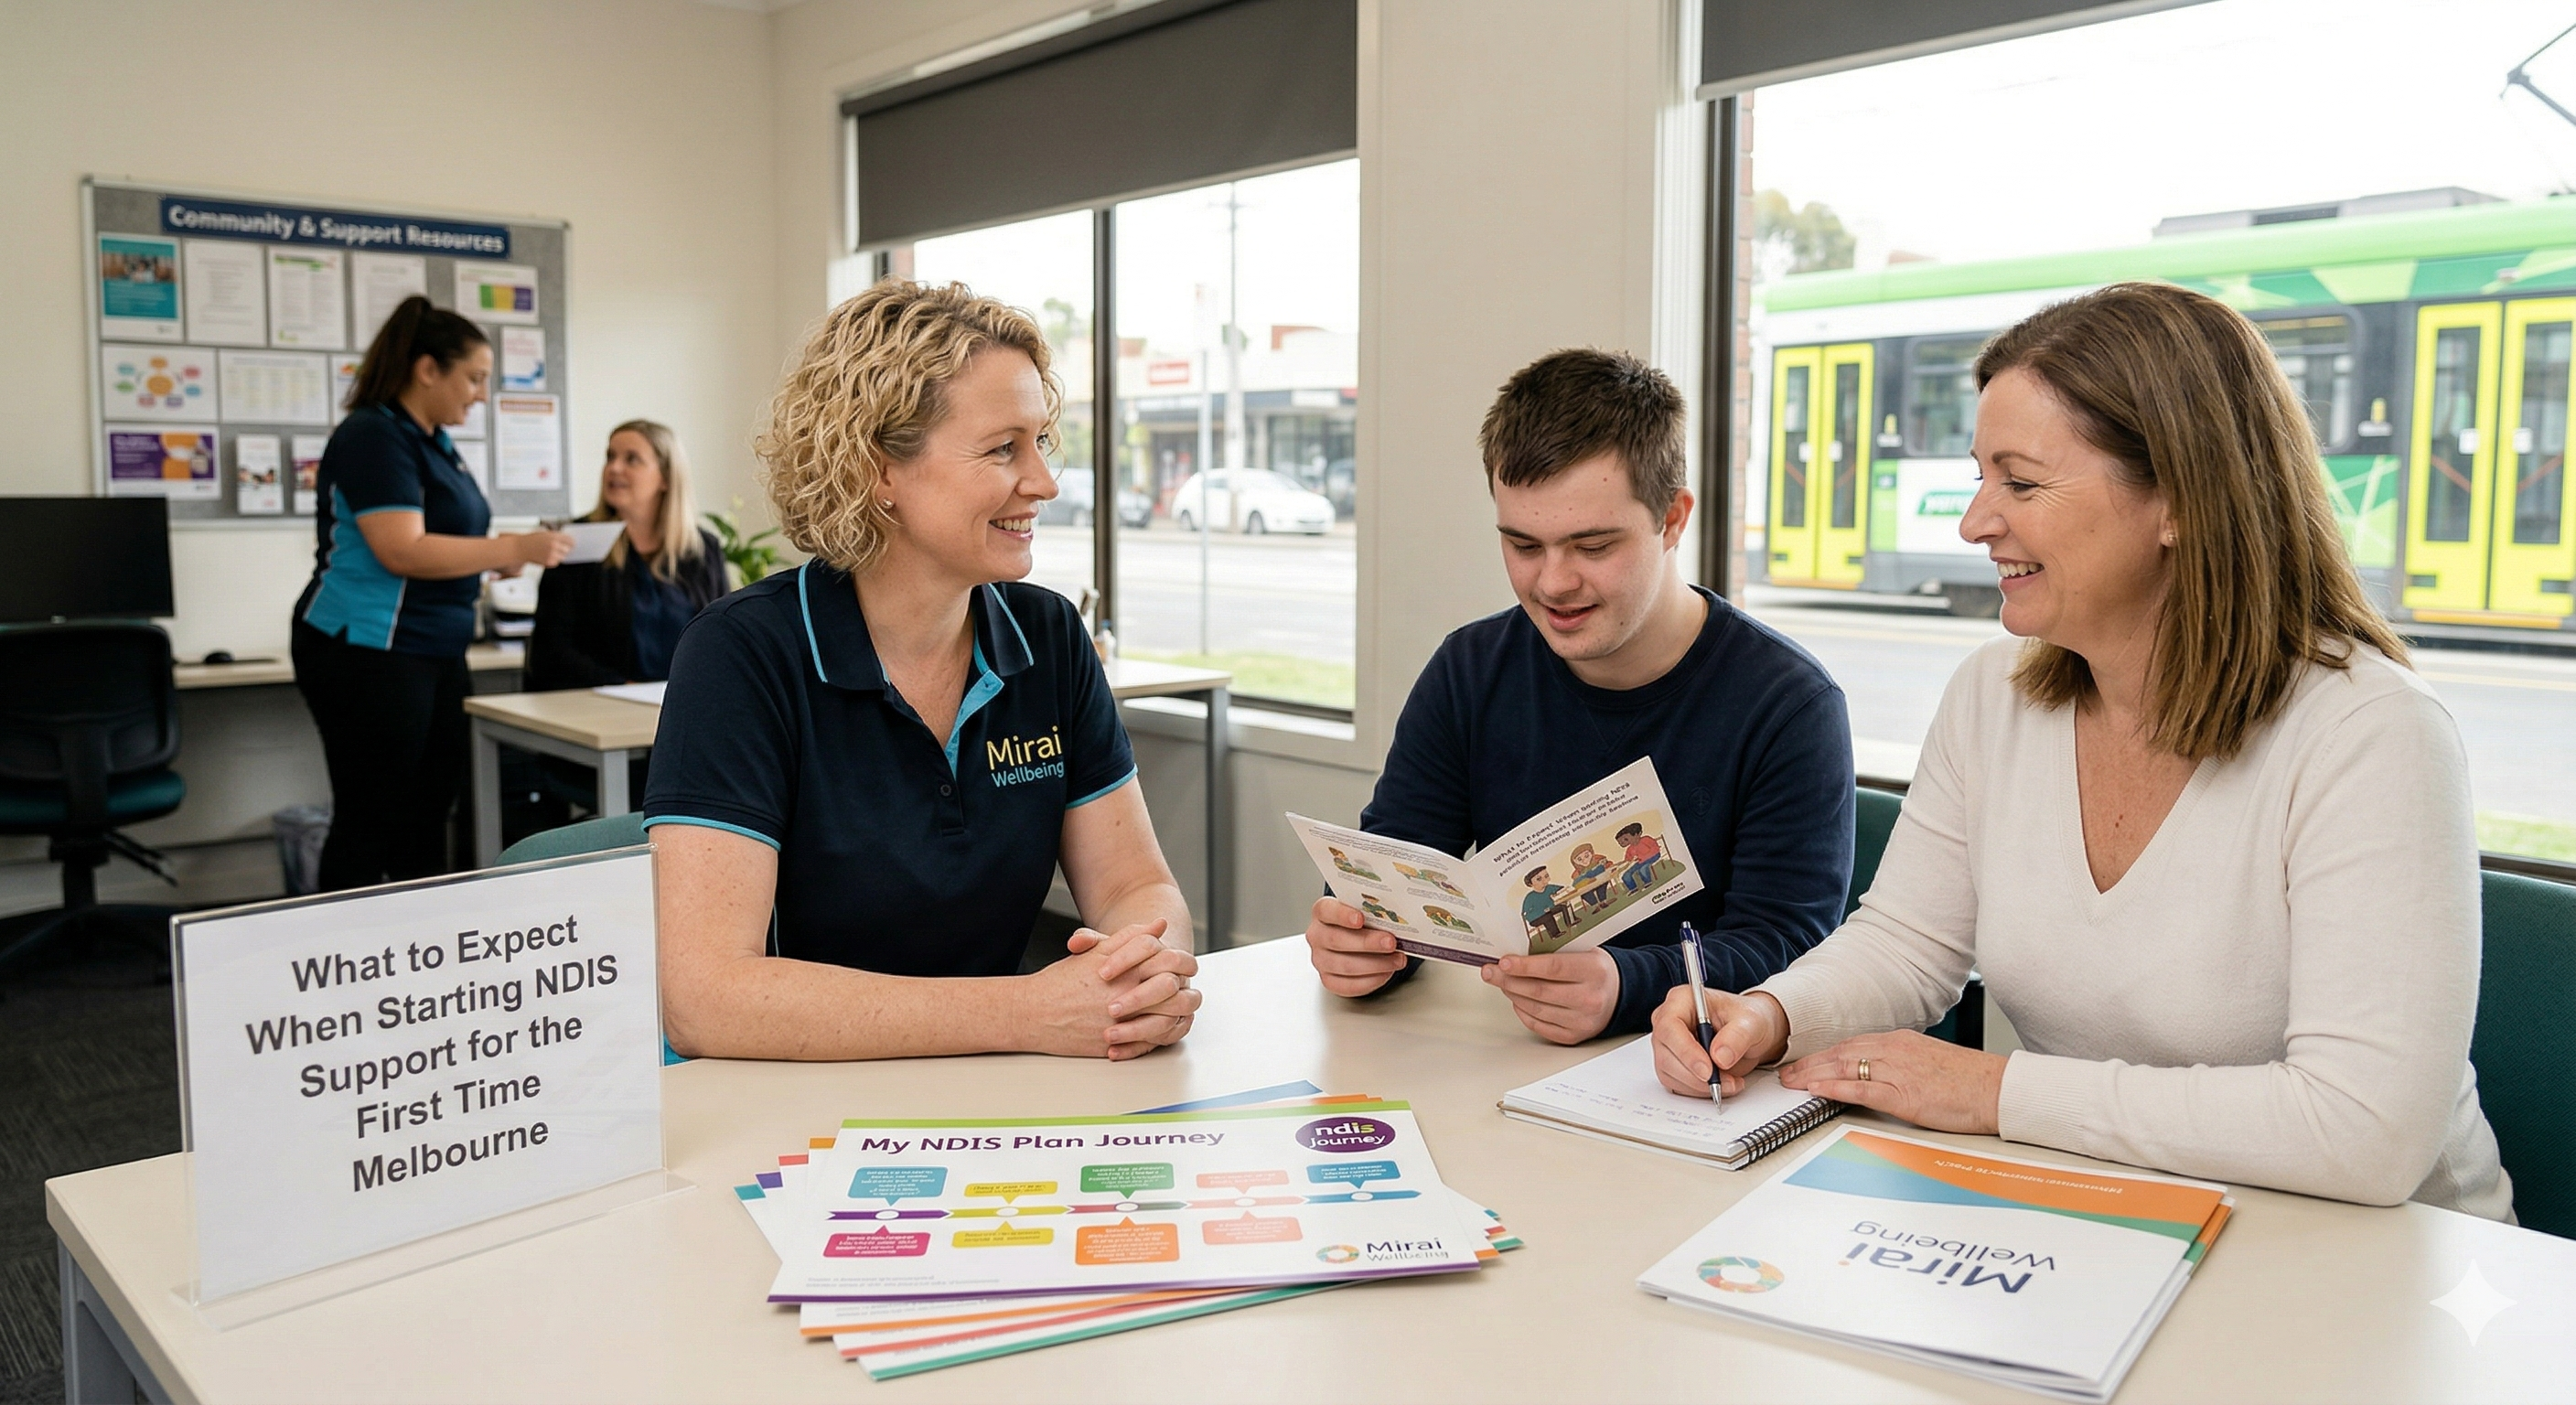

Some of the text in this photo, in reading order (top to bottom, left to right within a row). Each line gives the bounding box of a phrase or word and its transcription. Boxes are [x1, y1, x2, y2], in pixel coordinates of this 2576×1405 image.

[168, 204, 506, 253] Community & Support Resources
[987, 725, 1062, 770] Mirai
[992, 762, 1065, 787] Wellbeing
[292, 915, 578, 992] What to Expect
[246, 954, 619, 1055] When Starting NDIS
[300, 1016, 583, 1098] Support for the
[357, 1075, 542, 1139] First Time
[1315, 1122, 1376, 1137] ndis
[353, 1121, 549, 1193] Melbourne
[861, 1132, 1226, 1154] My NDIS Plan Journey
[1367, 1238, 1443, 1254] Mirai
[1838, 1243, 2034, 1294] Mirai
[1849, 1221, 2055, 1271] Wellbeing
